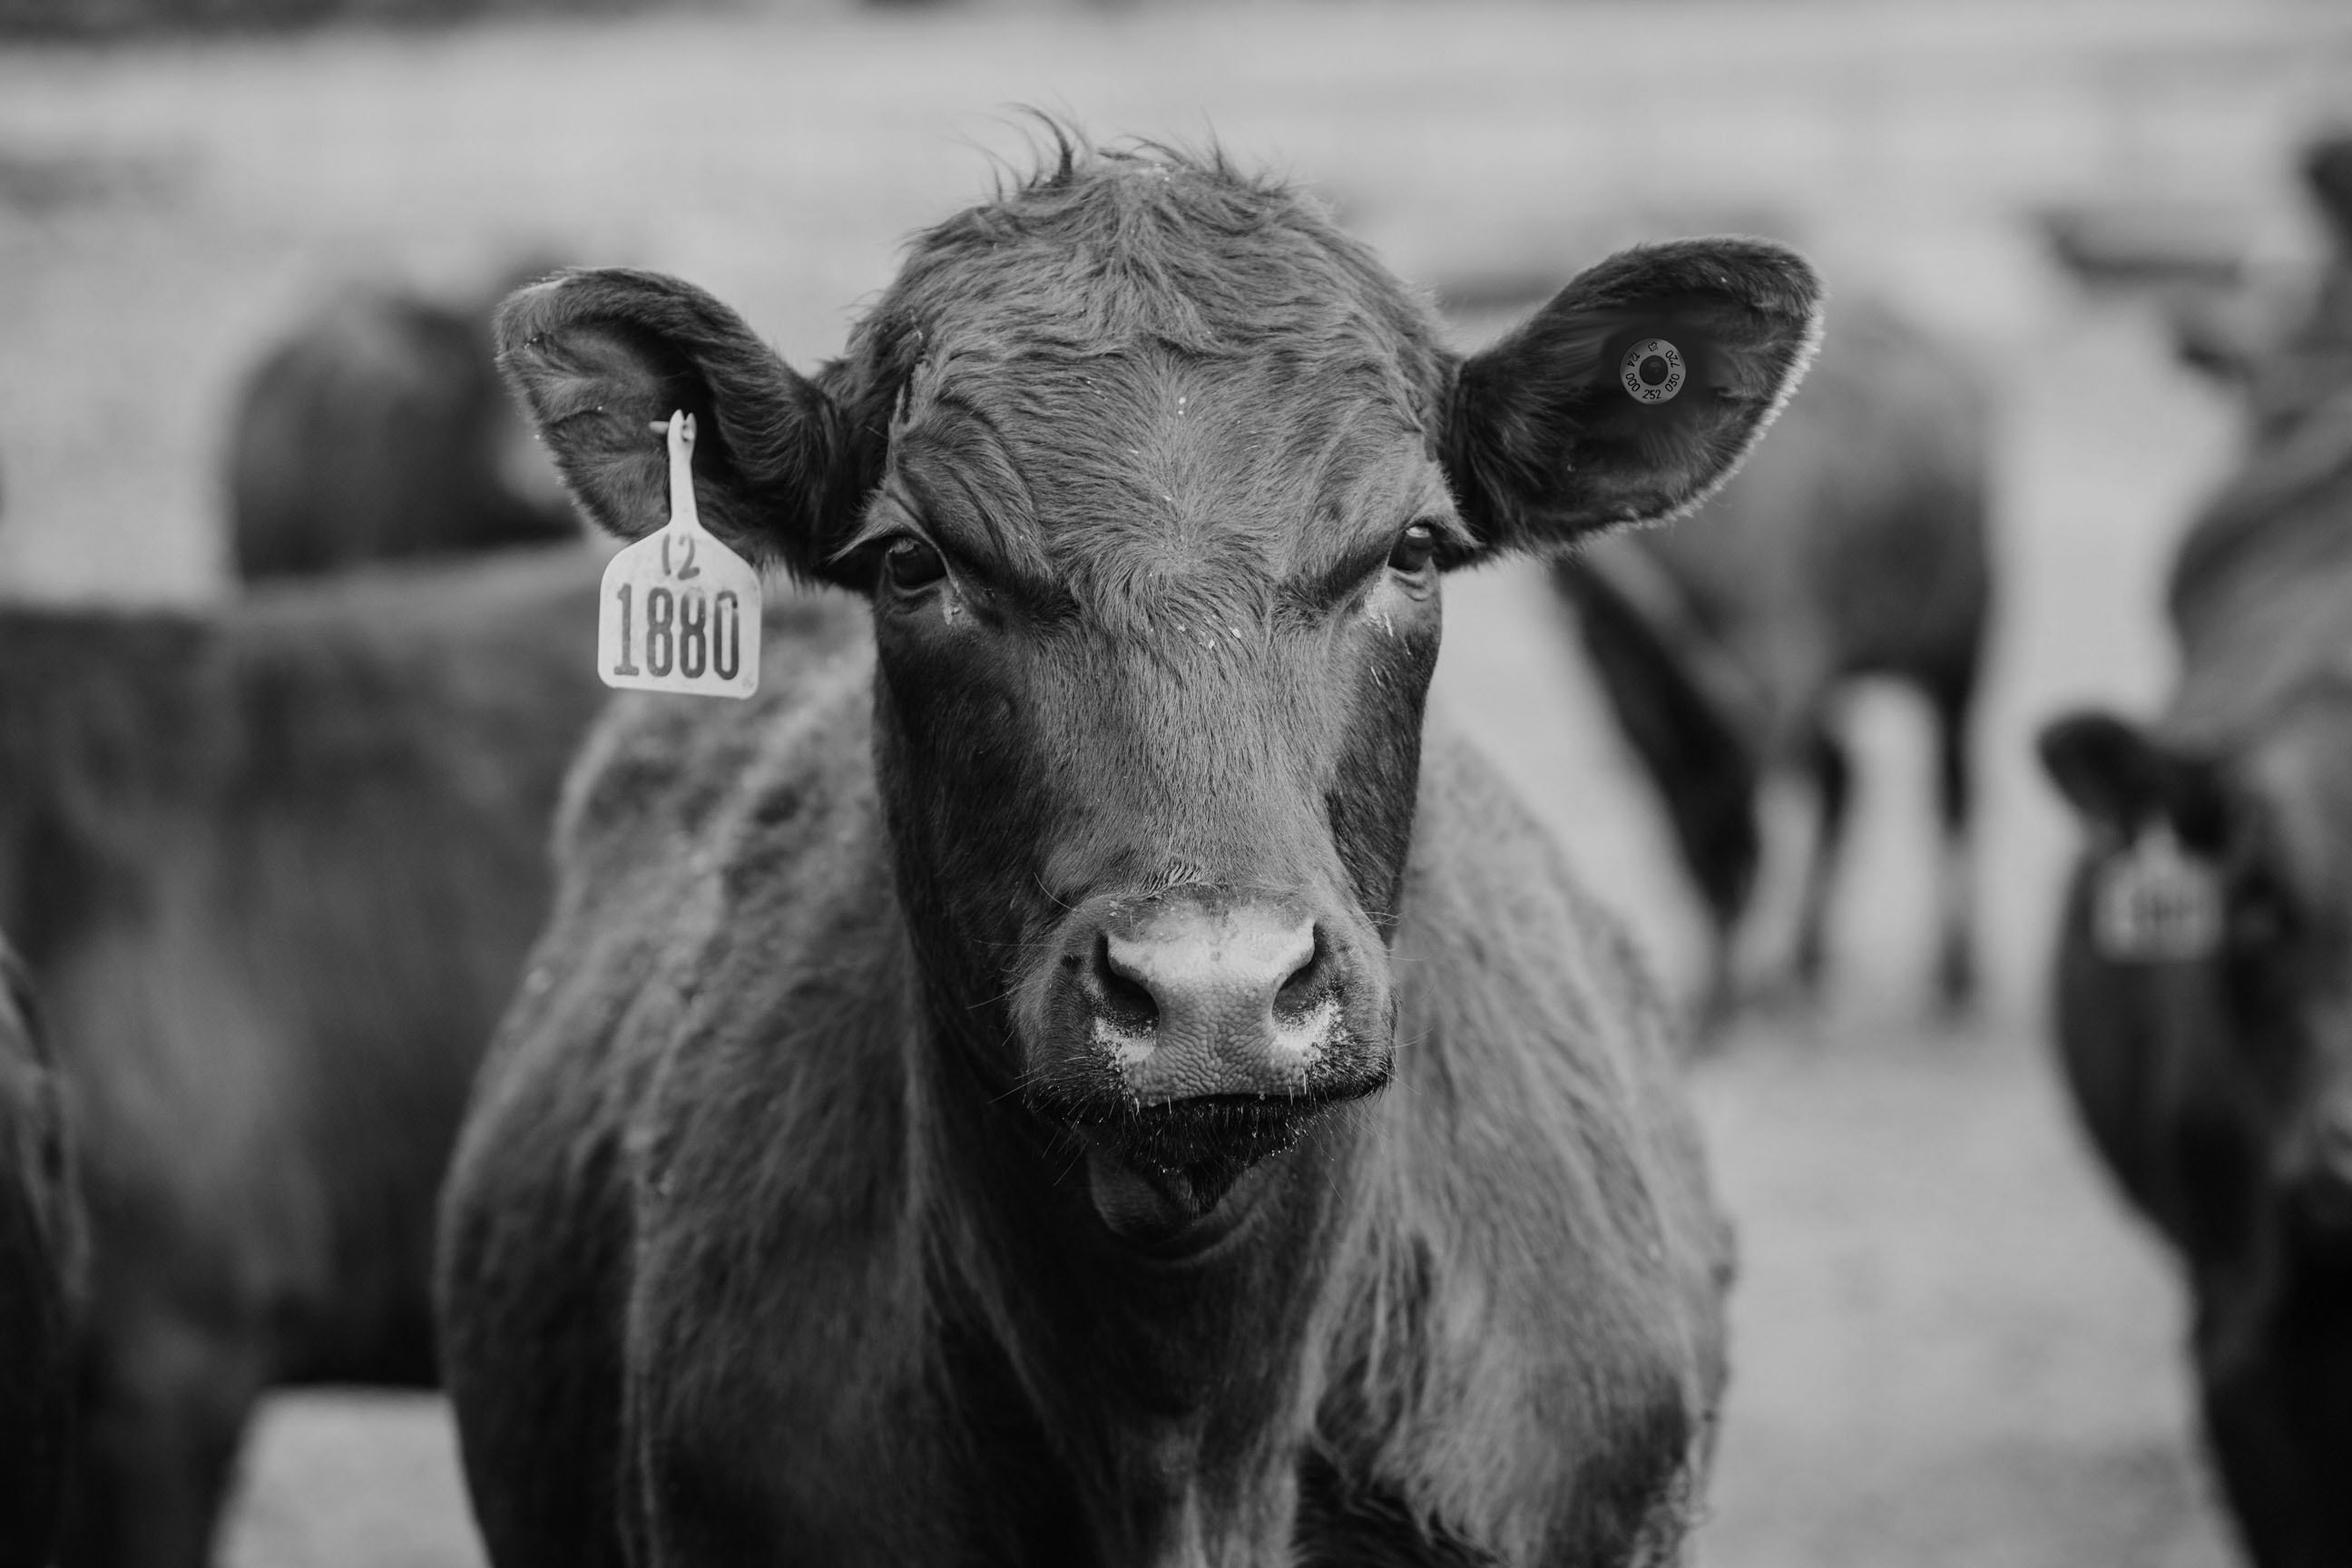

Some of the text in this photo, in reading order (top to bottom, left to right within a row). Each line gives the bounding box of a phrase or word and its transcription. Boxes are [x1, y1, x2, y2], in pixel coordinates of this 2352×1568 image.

[1625, 349, 1681, 399] 124 000 252 030 720
[662, 533, 701, 580] 12
[614, 583, 740, 681] 1880
